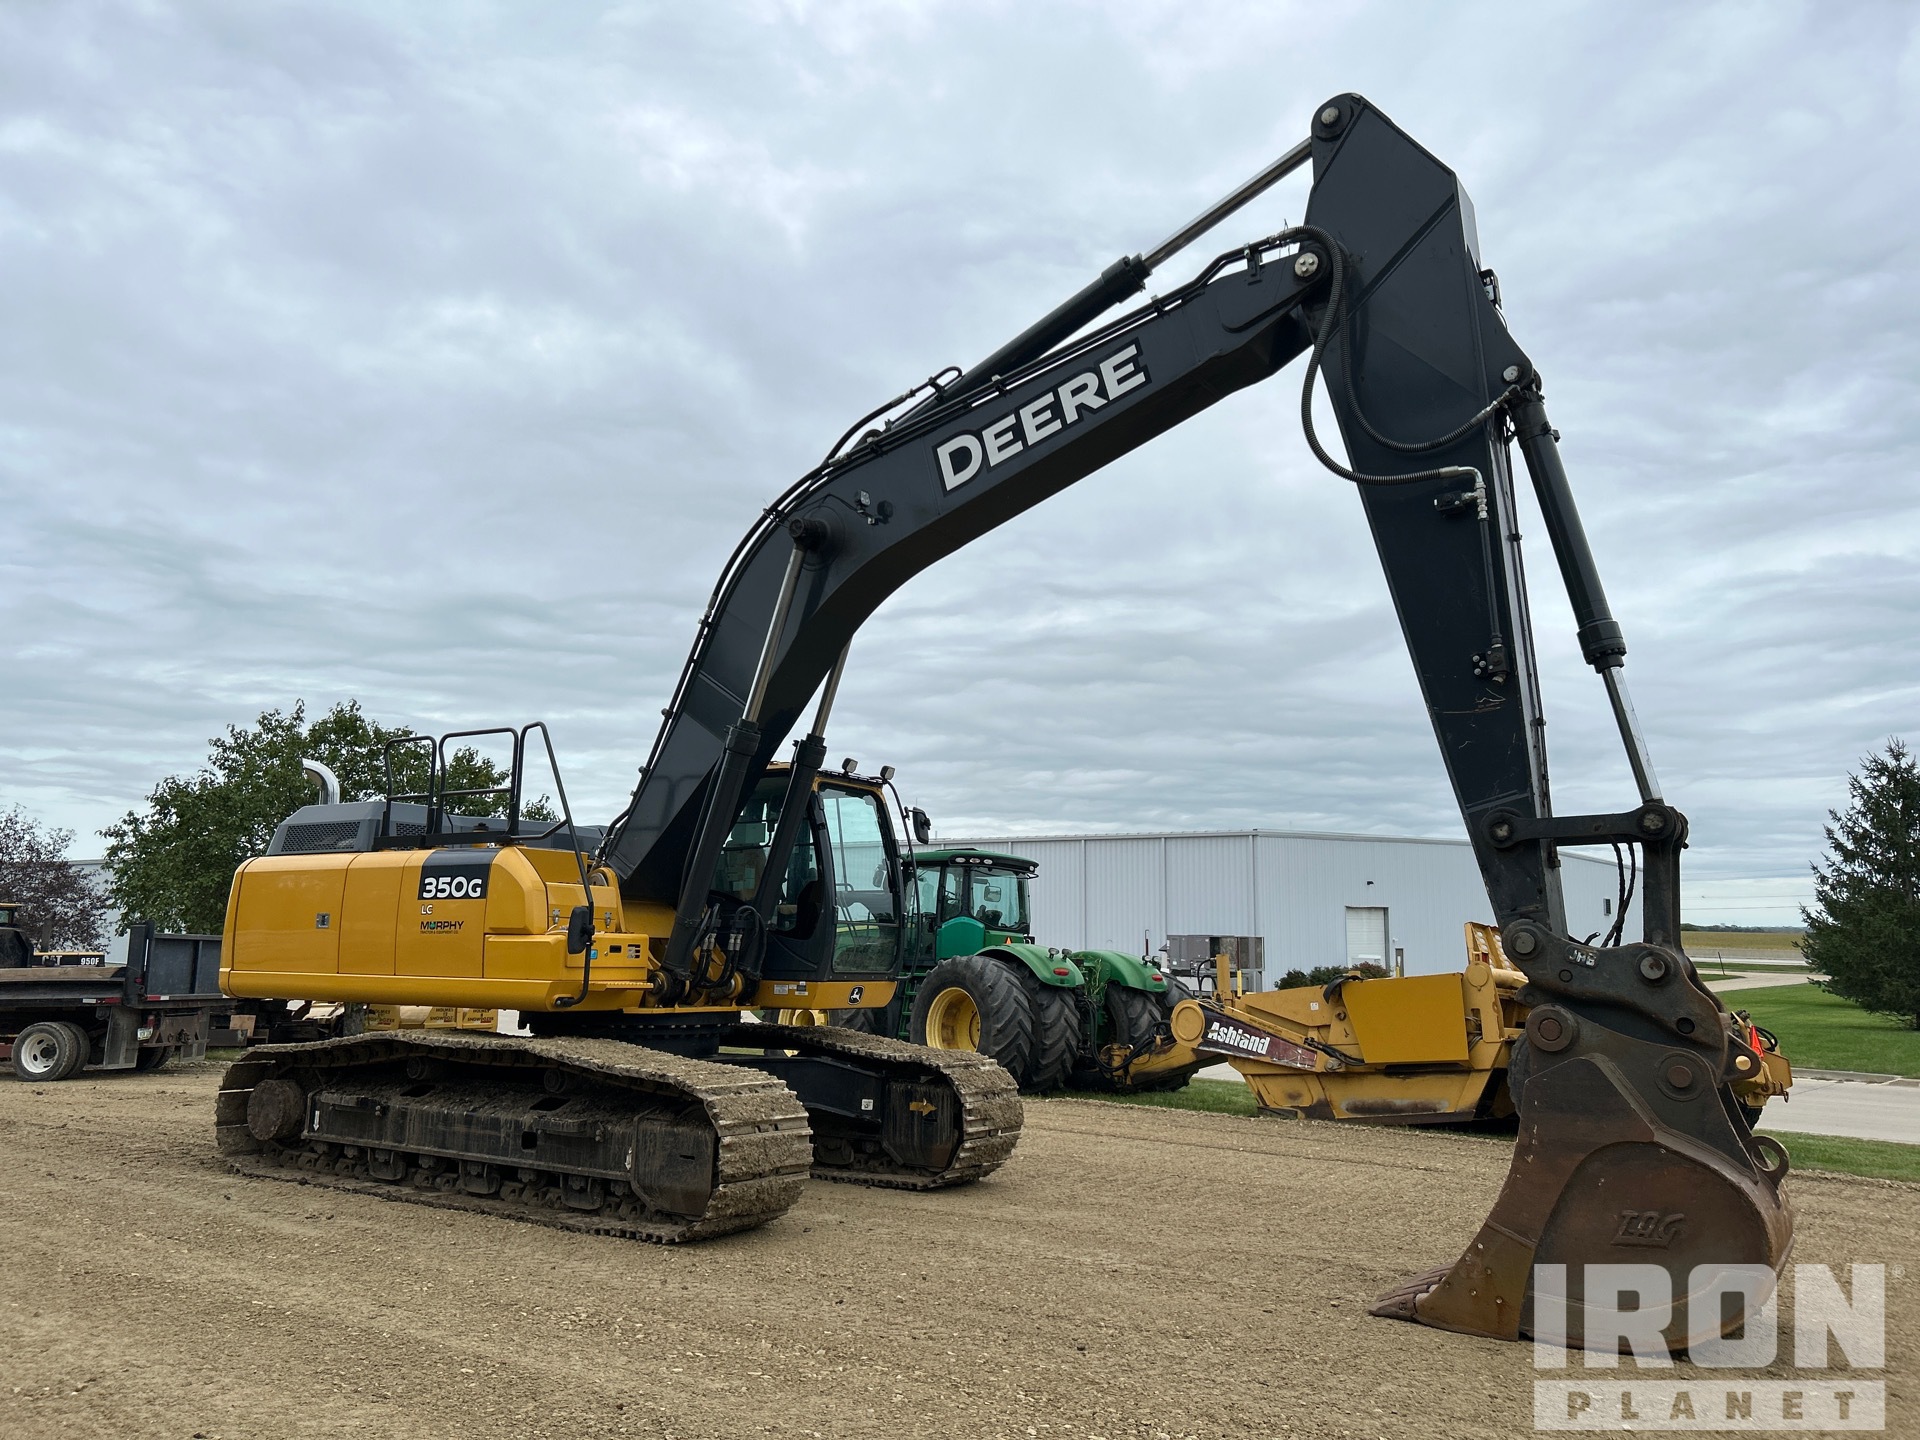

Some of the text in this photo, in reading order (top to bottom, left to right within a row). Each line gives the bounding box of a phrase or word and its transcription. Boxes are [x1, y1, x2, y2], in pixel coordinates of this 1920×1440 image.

[936, 343, 1147, 492] DEERE
[422, 876, 483, 898] 350G
[421, 904, 433, 915] LC
[420, 921, 464, 930] MURPHY
[1207, 1021, 1271, 1055] Ashland
